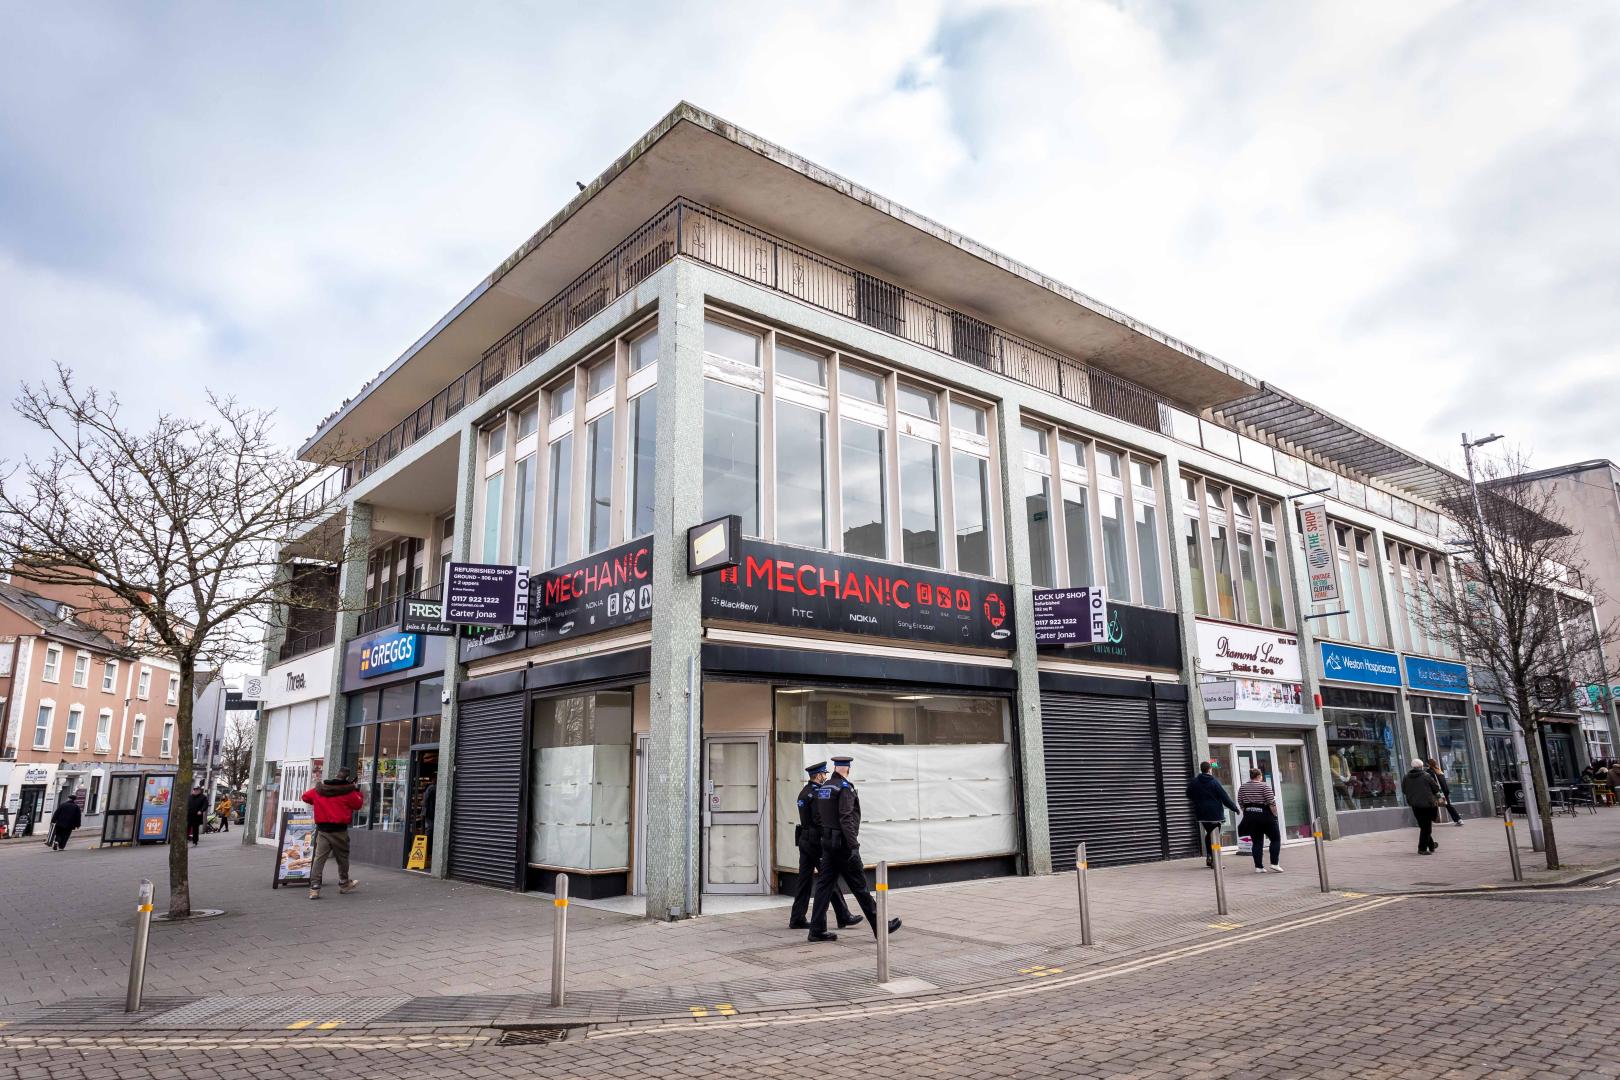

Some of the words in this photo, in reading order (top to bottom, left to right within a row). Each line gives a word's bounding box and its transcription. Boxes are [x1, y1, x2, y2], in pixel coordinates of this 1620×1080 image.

[1305, 510, 1317, 532] SHOP
[1308, 533, 1320, 549] THE
[454, 566, 496, 575] REFURBISHED
[517, 570, 530, 590] TO
[1313, 584, 1334, 592] CLOTHES
[451, 595, 468, 603] 0117
[468, 596, 483, 604] 922
[1066, 591, 1087, 599] SHOP
[1091, 589, 1103, 609] TO
[408, 602, 443, 619] FRES
[515, 593, 529, 621] LET
[586, 600, 604, 609] NOKIA
[720, 600, 759, 613] BlackBerry
[450, 609, 475, 618] Carter
[849, 613, 879, 624] NOKIA
[420, 623, 426, 631] &
[897, 620, 912, 629] Sony
[1092, 612, 1104, 638] LET
[1035, 631, 1057, 640] Carter
[370, 635, 413, 668] GREGGS
[1216, 636, 1259, 661] Diamond
[1231, 662, 1252, 673] Nails
[1252, 665, 1260, 673] &
[1260, 666, 1274, 676] Spa
[1342, 656, 1365, 669] Weston
[1365, 658, 1397, 675] Hospicecare
[1222, 695, 1234, 703] Spa
